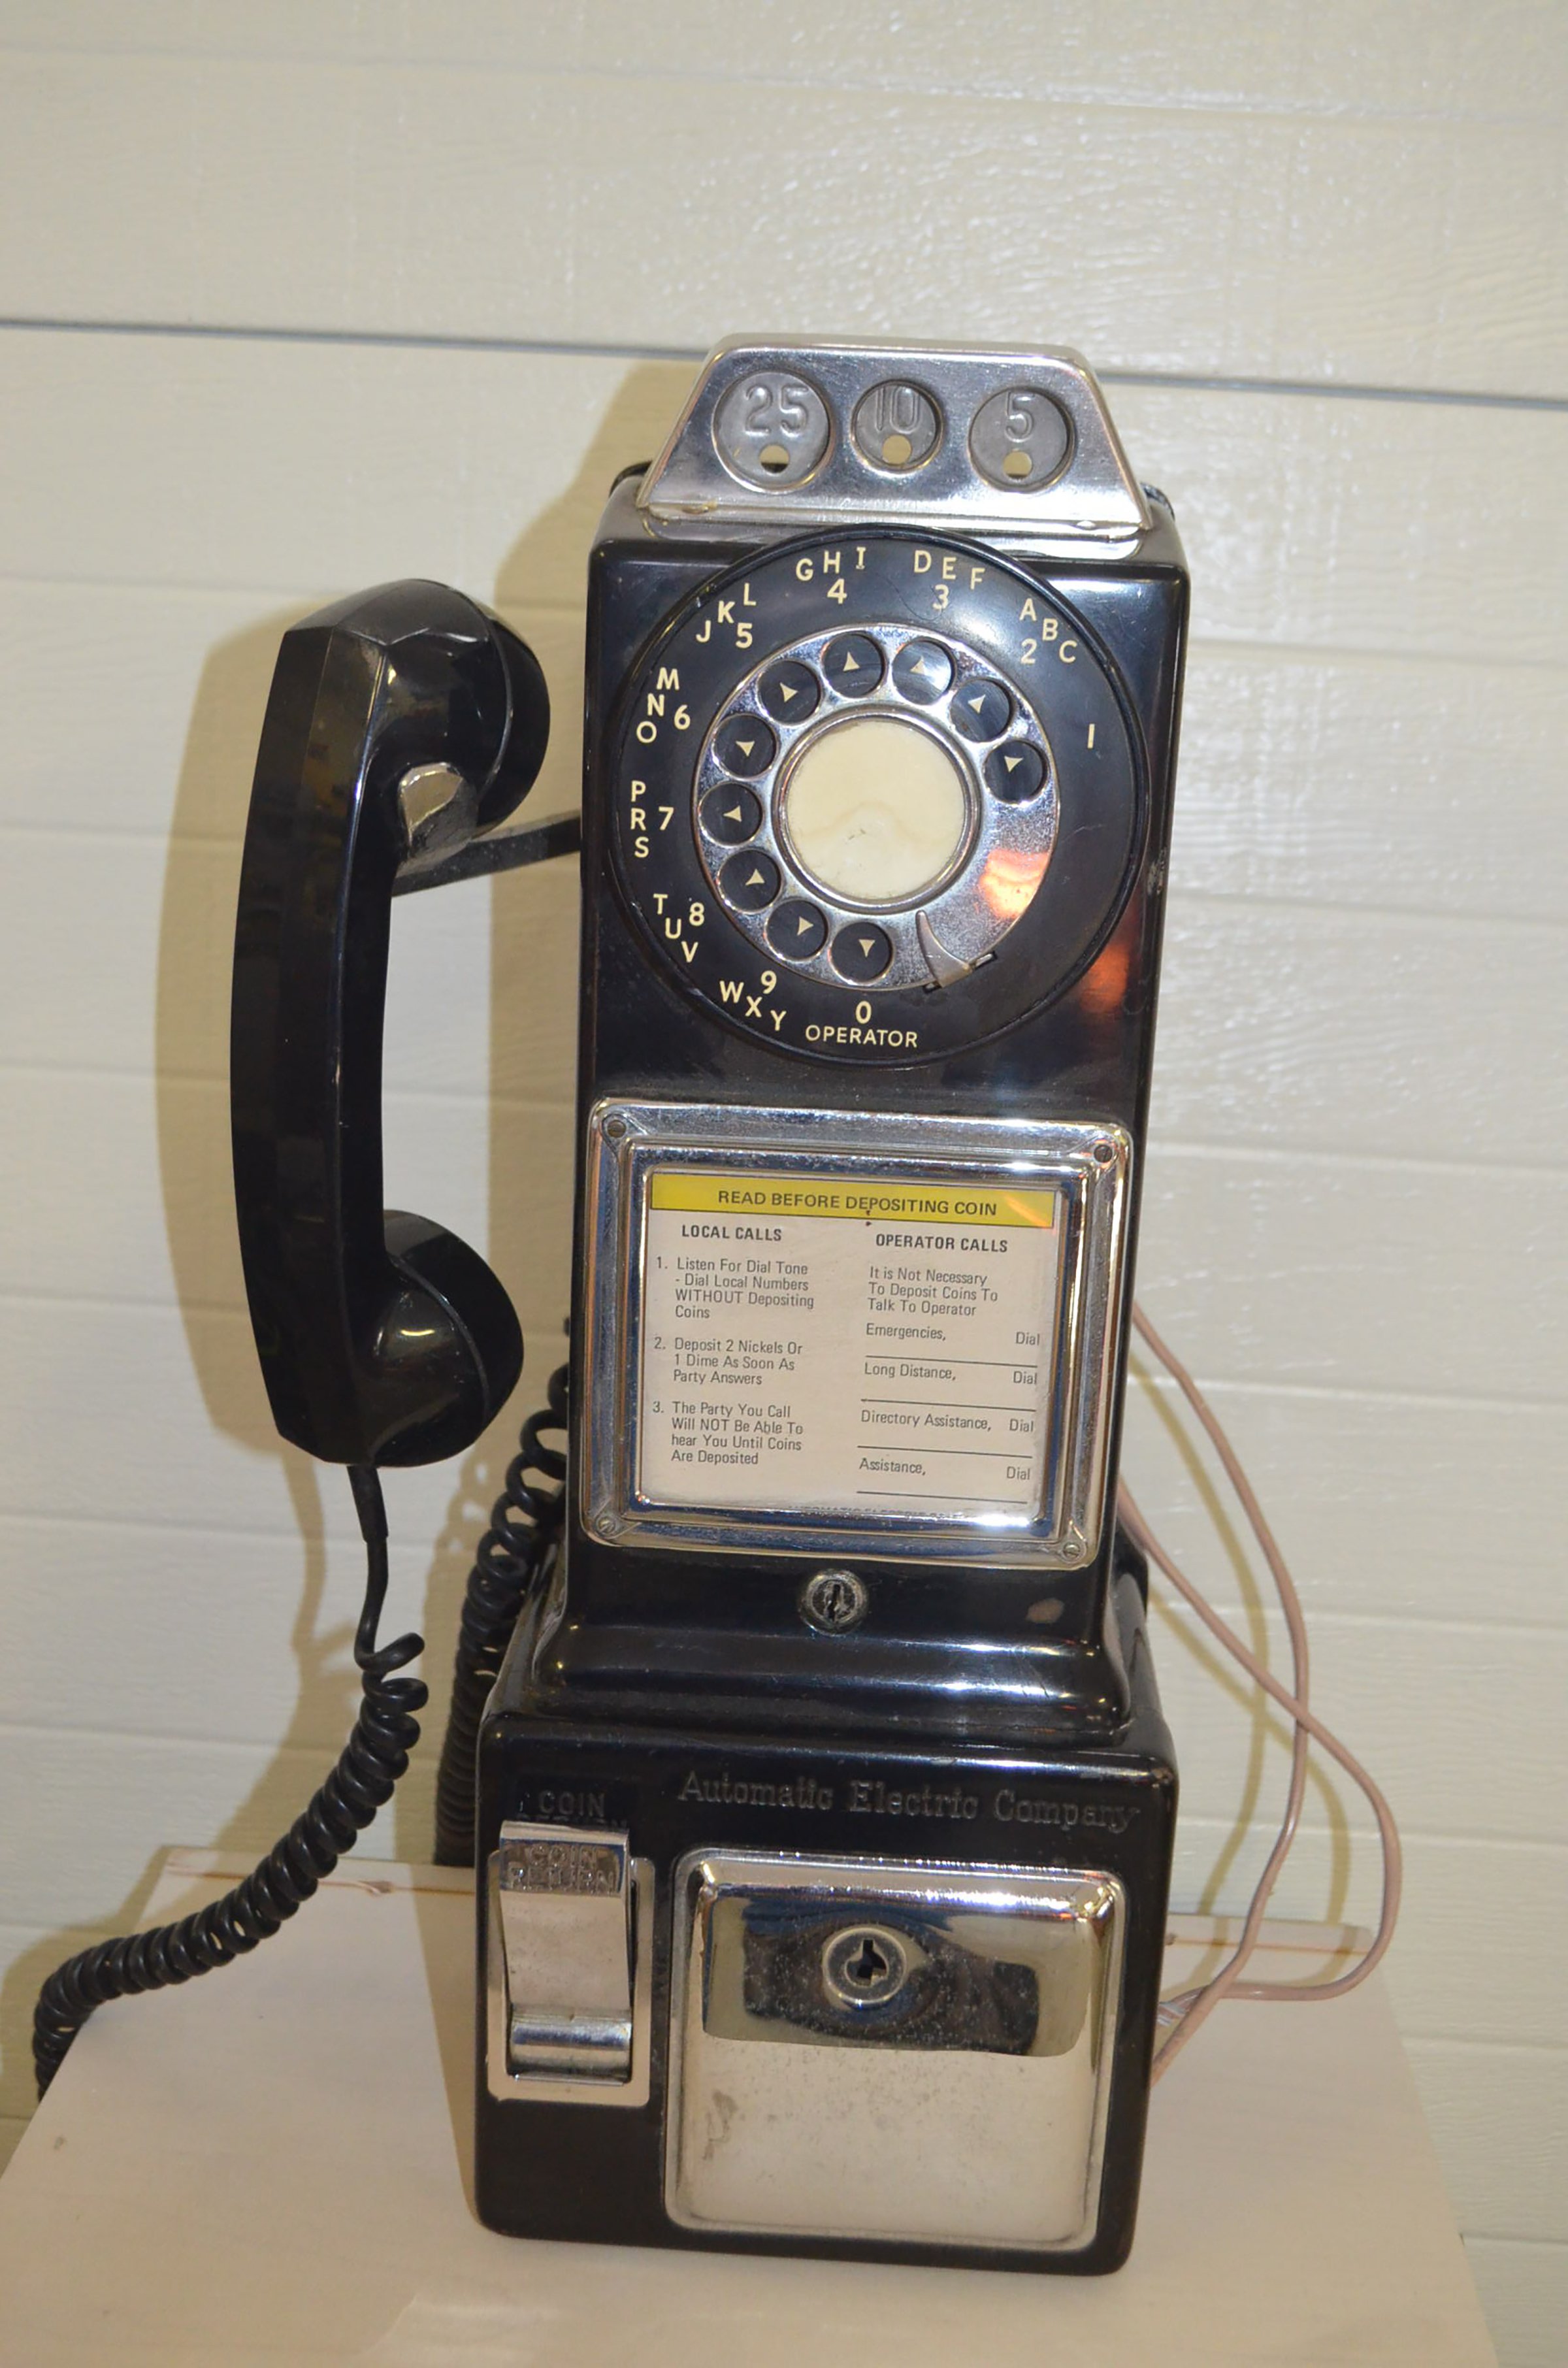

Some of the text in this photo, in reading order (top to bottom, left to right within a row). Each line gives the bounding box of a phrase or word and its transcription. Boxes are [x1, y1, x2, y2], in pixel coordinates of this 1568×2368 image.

[744, 384, 809, 438] 25
[875, 386, 922, 435] 10
[1004, 391, 1035, 443] 5
[827, 578, 847, 604] 4
[933, 584, 949, 609] 3
[736, 621, 753, 648] 5
[1021, 639, 1037, 664] 2
[674, 704, 691, 730] 6
[659, 806, 674, 830] 7
[689, 903, 705, 927] 8
[760, 970, 777, 995] 9
[855, 1001, 872, 1024] 0
[806, 1025, 917, 1048] OPERATOR
[719, 1191, 996, 1215] READ BEFORE DEPOSITING COIN
[682, 1225, 782, 1241] LOCAL CALLS
[876, 1234, 1007, 1253] OPERATOR CALLS
[657, 1257, 808, 1275] 1. Listen For Dial Tone
[870, 1267, 987, 1287] It is Not Necessary
[685, 1274, 709, 1287] Dial
[715, 1275, 747, 1288] Local
[753, 1277, 809, 1291] Numbers
[868, 1282, 998, 1301] To Deposit Coins To
[676, 1289, 814, 1309] WITHOUT Depositing
[868, 1298, 976, 1316] Talk To Operator
[676, 1306, 710, 1319] Coins
[866, 1323, 1040, 1345] Emergencies, Dial
[654, 1337, 802, 1354] 2. Deposit 2 Nickels Or
[675, 1354, 794, 1370] 1 Dime As Soon As
[864, 1362, 1037, 1384] Long Distance, Dial
[674, 1370, 762, 1385] Party Answers
[653, 1402, 790, 1417] 3. The Party You Call
[861, 1409, 1034, 1432] Directory Assistance, Dial
[672, 1418, 803, 1434] Will NOT Be Able To
[672, 1434, 802, 1451] hear You Until Coins
[671, 1450, 759, 1465] Are Deposited
[859, 1458, 1030, 1480] Assistance, Dial
[538, 1790, 605, 1817] COIN
[678, 1769, 1141, 1834] Automatic Electric Company
